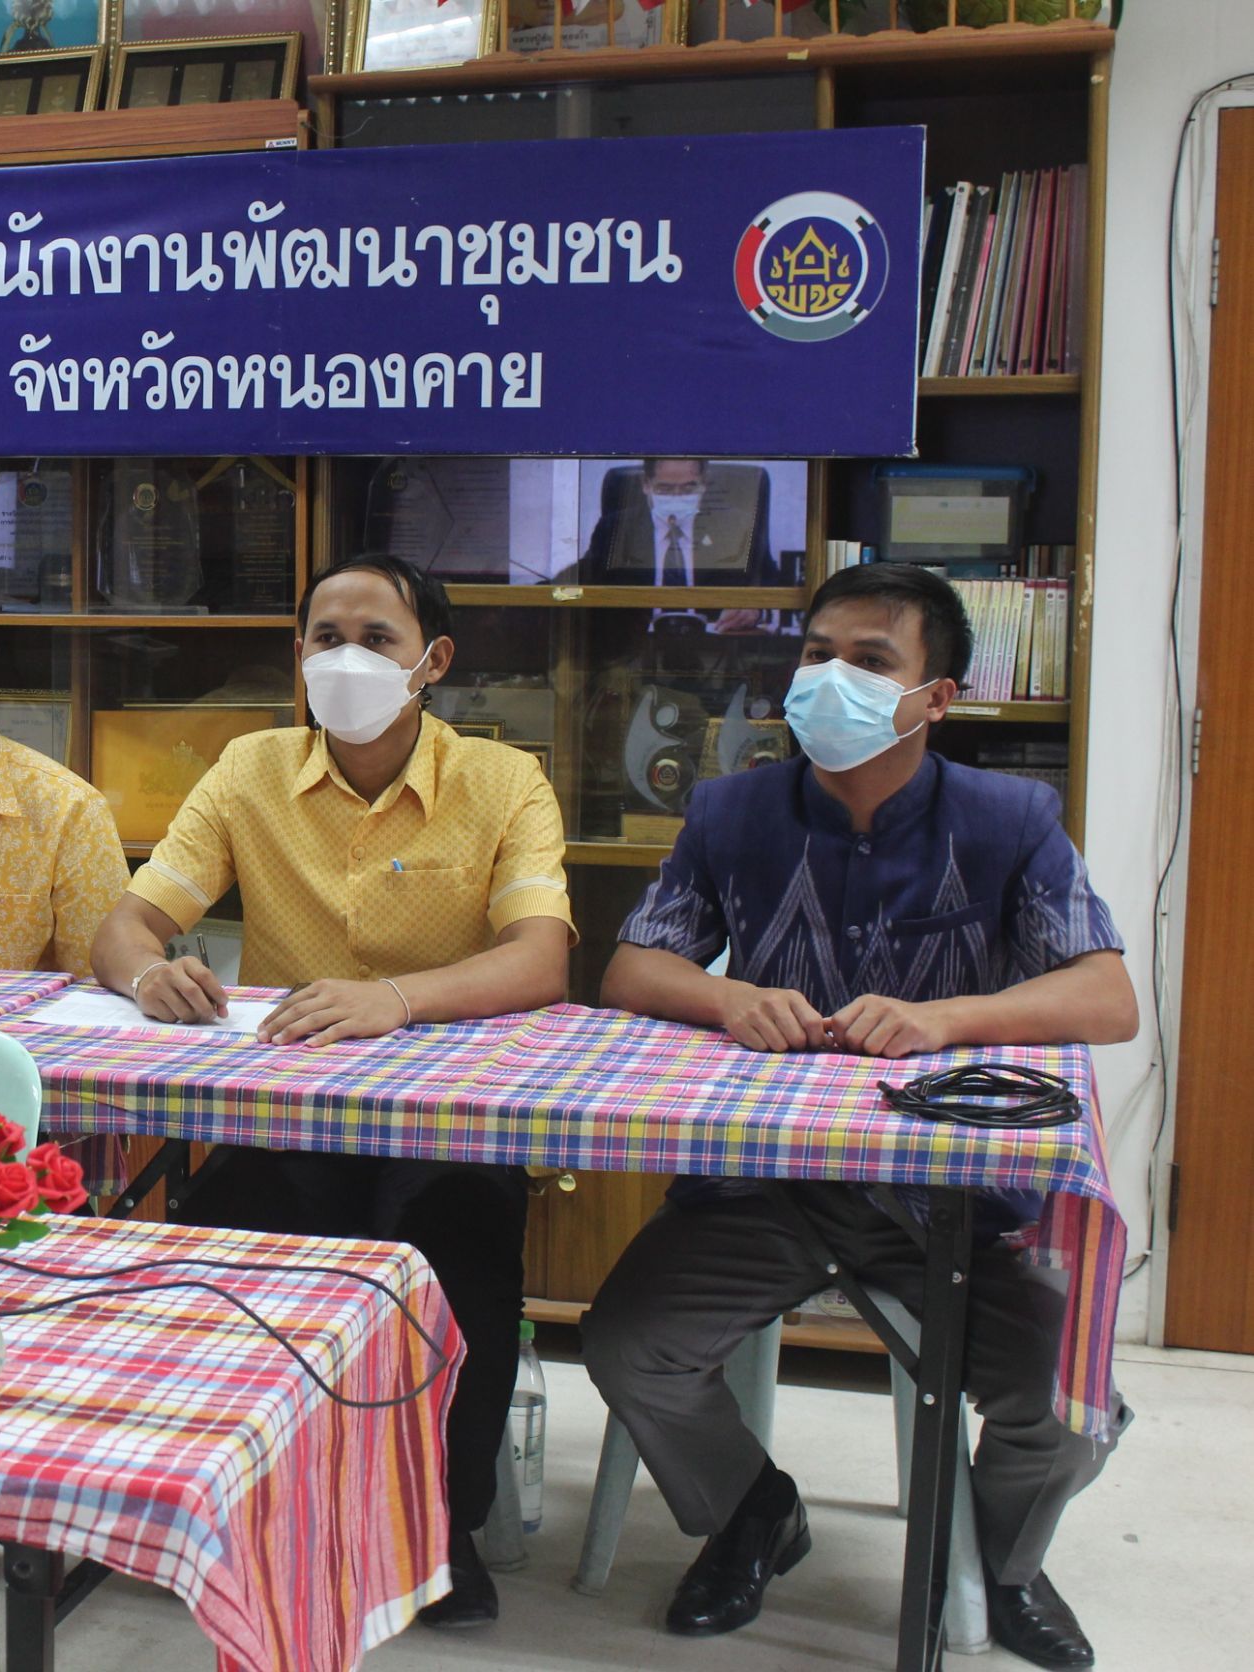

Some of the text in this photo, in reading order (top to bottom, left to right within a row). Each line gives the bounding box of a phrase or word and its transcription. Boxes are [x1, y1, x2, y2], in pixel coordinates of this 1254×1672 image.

[9, 330, 543, 413] จังหวัดหนองคาย
